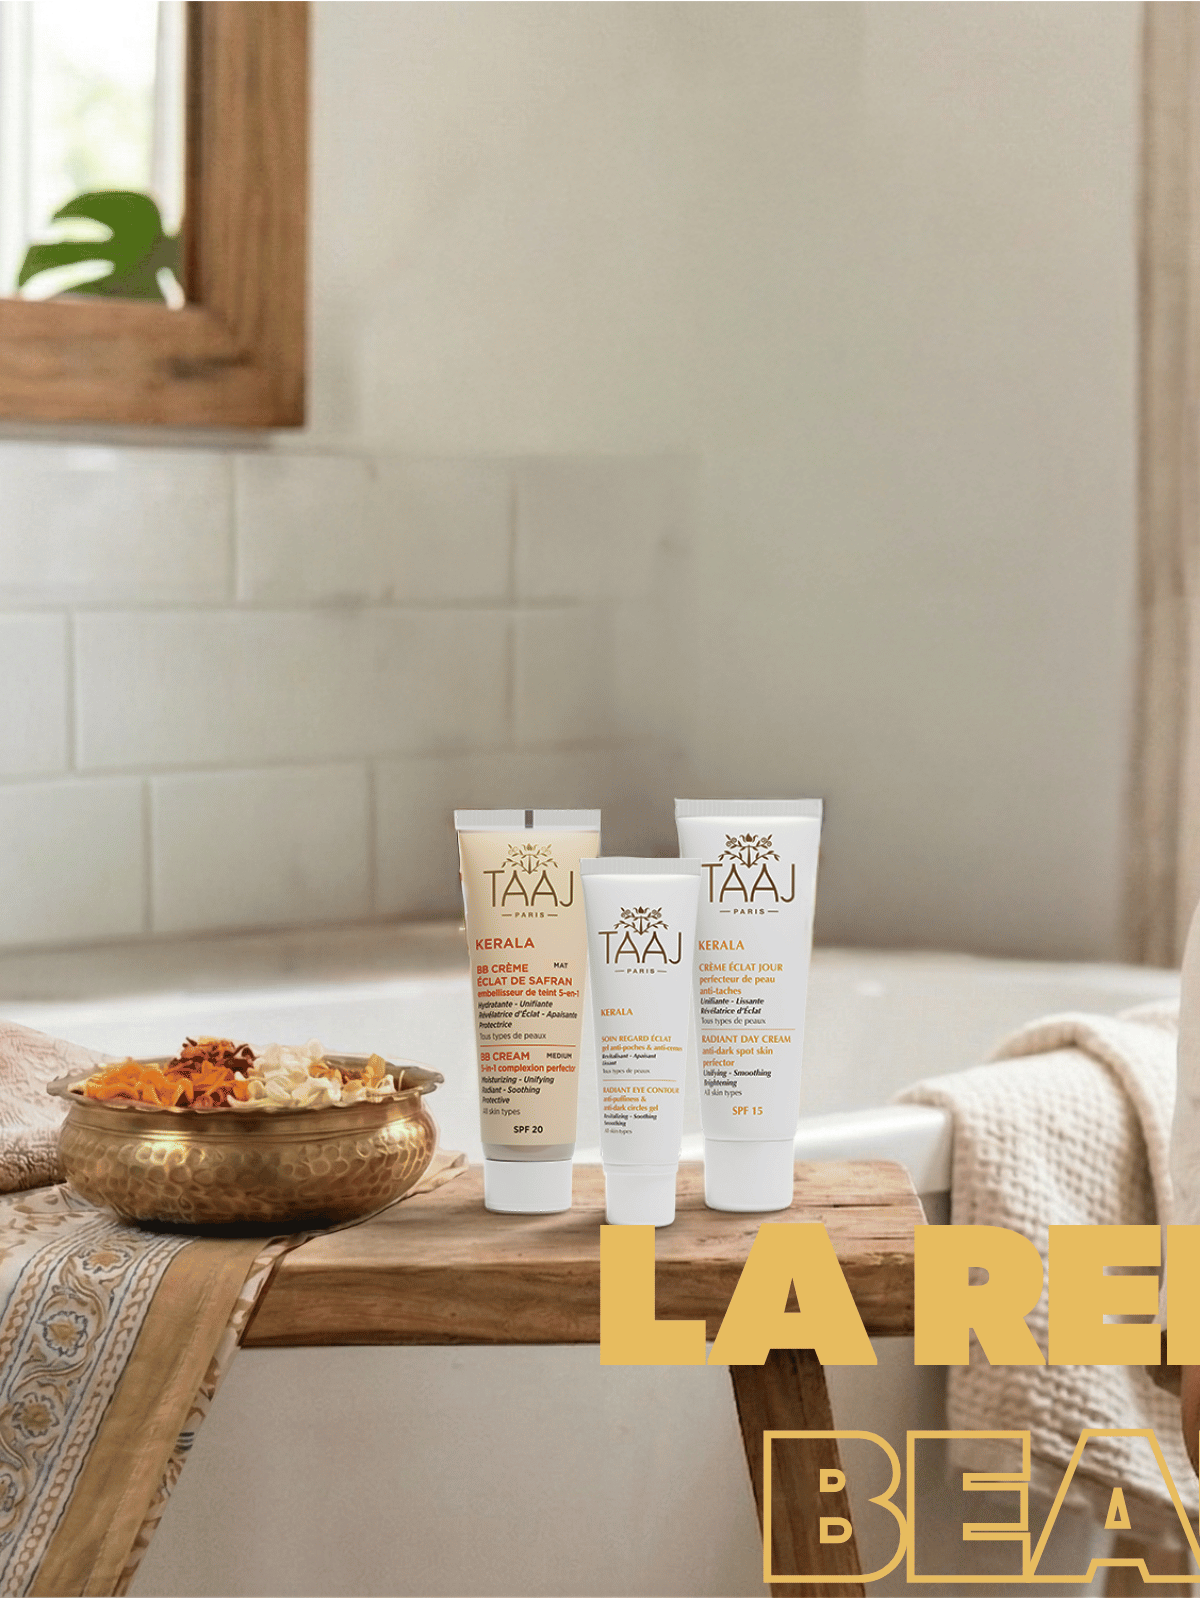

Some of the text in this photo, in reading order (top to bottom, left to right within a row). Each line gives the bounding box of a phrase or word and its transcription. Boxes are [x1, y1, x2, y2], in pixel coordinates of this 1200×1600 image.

[701, 863, 795, 903] TAAJ
[483, 870, 574, 907] TAAJ
[475, 937, 535, 951] KERALA
[598, 931, 682, 964] TAAJ
[698, 940, 745, 950] KERALA
[477, 962, 529, 974] BB CRÈME
[699, 961, 783, 973] CRÈME ÉCLAT JOUR
[477, 975, 573, 987] ÉCLAT DE SAFRAN
[700, 975, 776, 985] perfecteur de peau
[700, 986, 742, 995] anti-taches
[520, 1000, 553, 1008] Unifiante
[601, 1008, 633, 1017] KERALA
[702, 1035, 791, 1043] RADIANT DAY CREAM
[493, 1052, 530, 1061] CREAM
[736, 1047, 754, 1057] spot
[756, 1047, 773, 1055] skin
[703, 1058, 735, 1068] perfector
[498, 1064, 544, 1073] complexion
[733, 1069, 772, 1078] Smoothing
[524, 1076, 554, 1084] Unifying
[507, 1086, 541, 1095] Soothing
[732, 1106, 763, 1115] SPF 15
